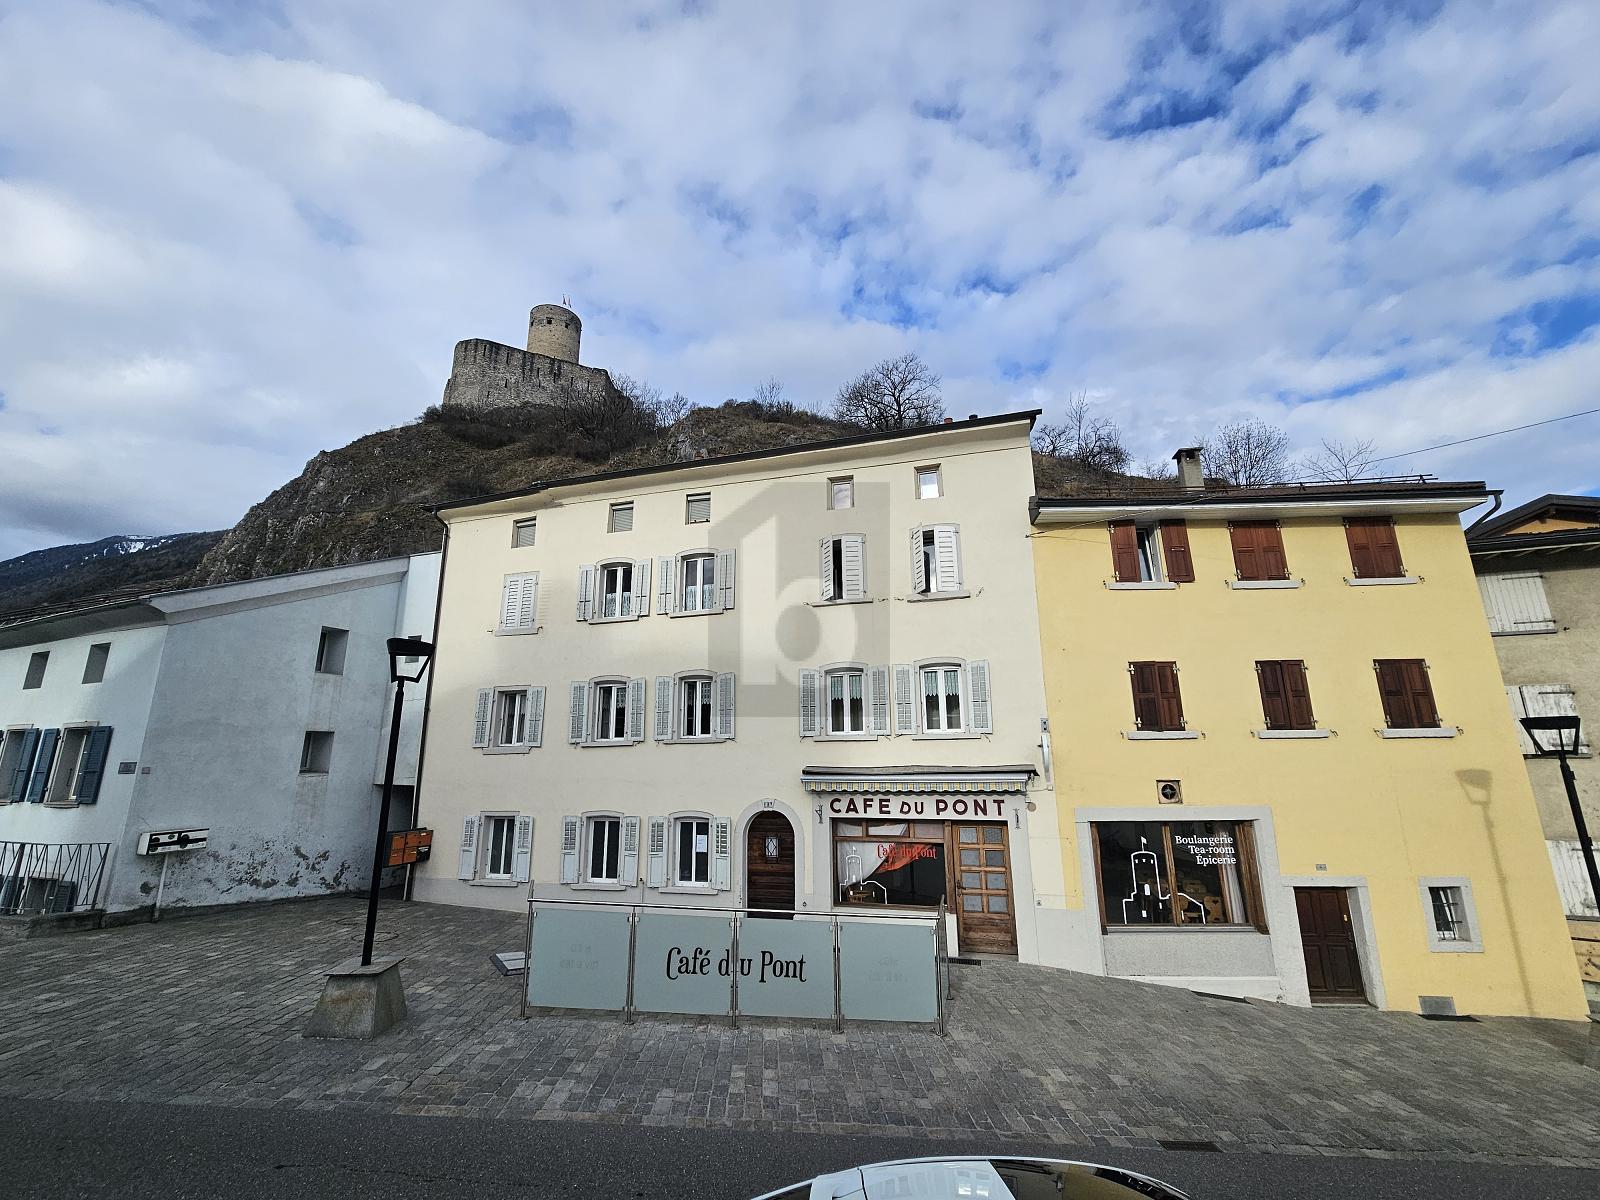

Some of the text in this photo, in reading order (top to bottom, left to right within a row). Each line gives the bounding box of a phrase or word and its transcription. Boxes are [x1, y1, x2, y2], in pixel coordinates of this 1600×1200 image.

[829, 797, 1005, 816] CAFE DU PONT
[1175, 834, 1233, 846] Boulangerie
[900, 844, 912, 857] du
[913, 844, 937, 860] Pont
[1188, 845, 1235, 854] Tea-room
[1196, 854, 1237, 867] Épicerie
[666, 947, 807, 983] Café du Pont
